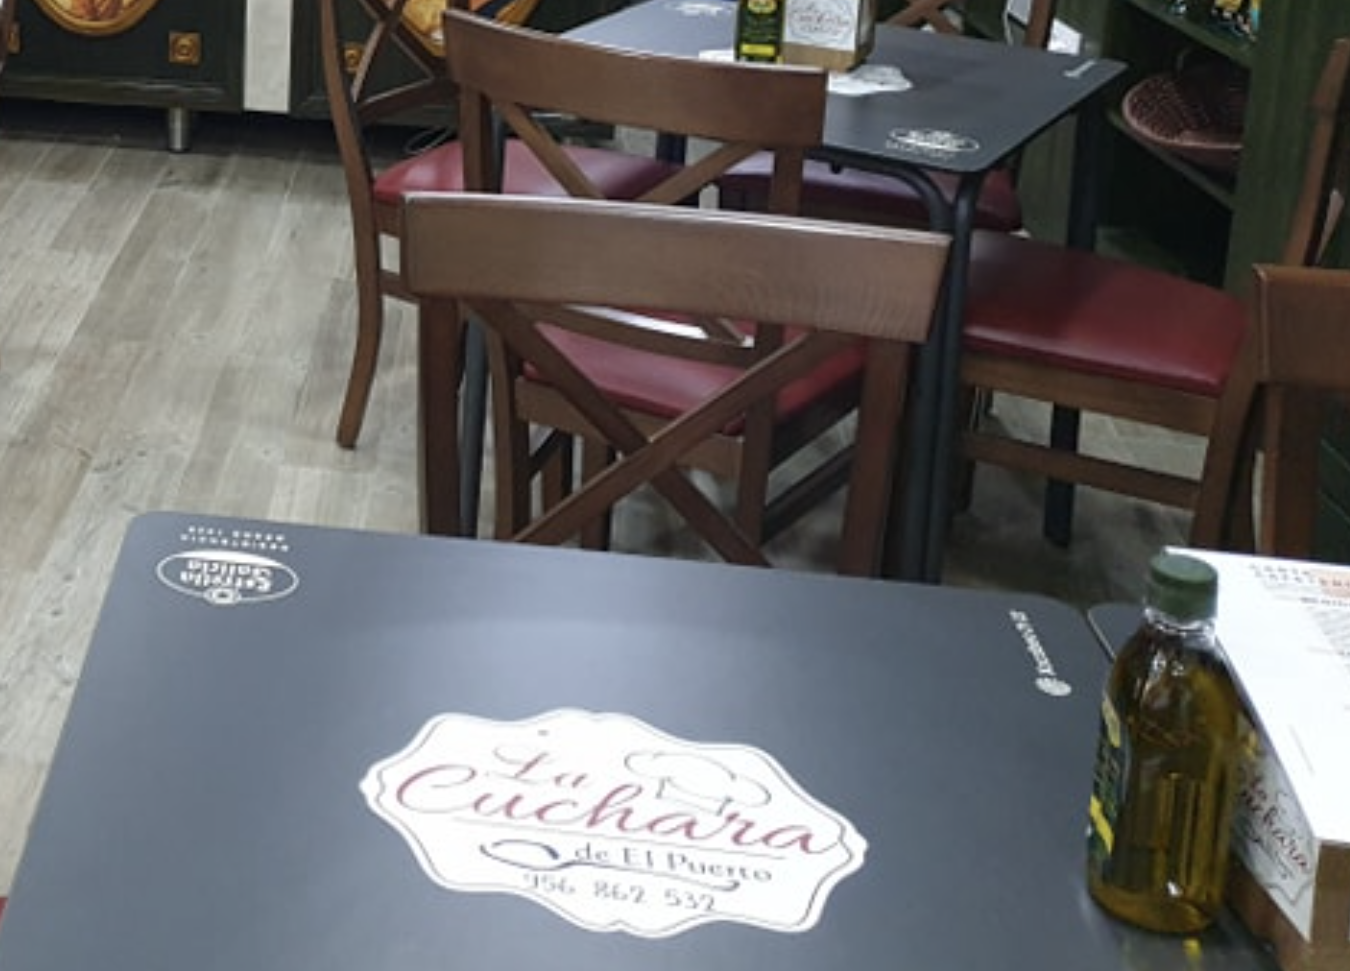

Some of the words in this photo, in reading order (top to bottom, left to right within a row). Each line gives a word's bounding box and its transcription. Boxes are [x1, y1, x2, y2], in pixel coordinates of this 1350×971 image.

[493, 746, 591, 789] La
[396, 764, 840, 854] Cuchara
[573, 842, 609, 863] de
[621, 846, 659, 867] El
[666, 851, 773, 882] Puerto
[522, 872, 577, 897] 956
[592, 881, 646, 905] 862
[662, 888, 717, 912] 532
